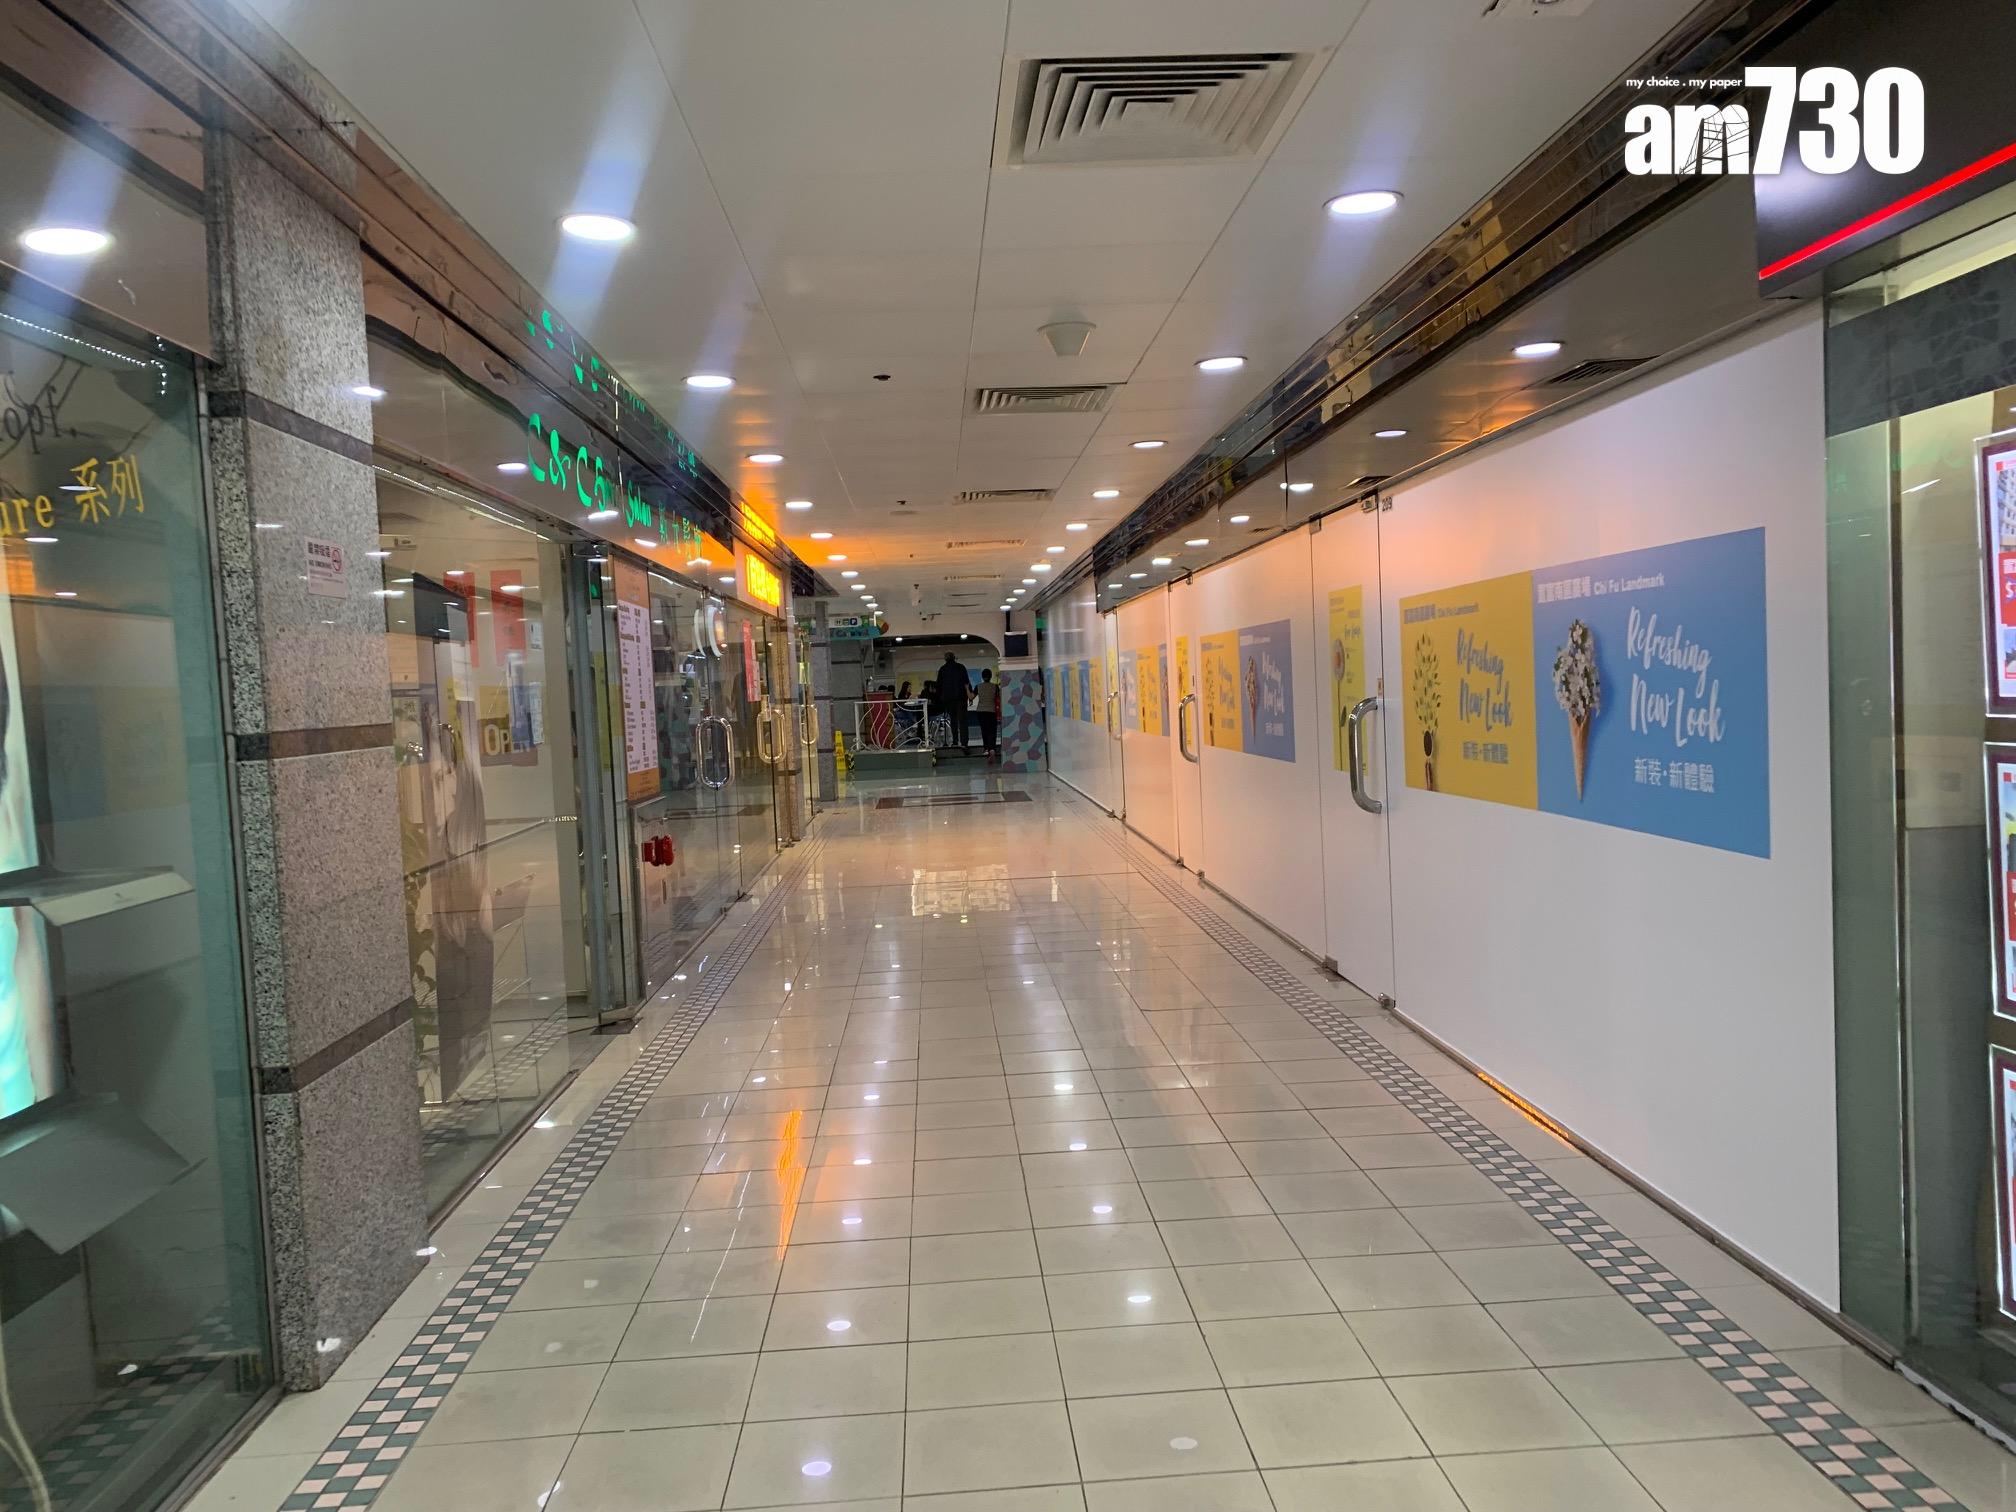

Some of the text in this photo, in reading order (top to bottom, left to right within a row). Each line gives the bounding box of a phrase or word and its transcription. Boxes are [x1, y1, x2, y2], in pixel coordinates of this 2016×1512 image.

[69, 454, 144, 523] 系列
[1594, 580, 1608, 595] Chi
[1609, 579, 1619, 593] Fu
[1621, 572, 1665, 592] Landmark
[1457, 627, 1505, 695] Refreshing
[1627, 606, 1712, 698] Refreshing
[1460, 678, 1513, 732] New Look
[1631, 674, 1726, 747] New Look
